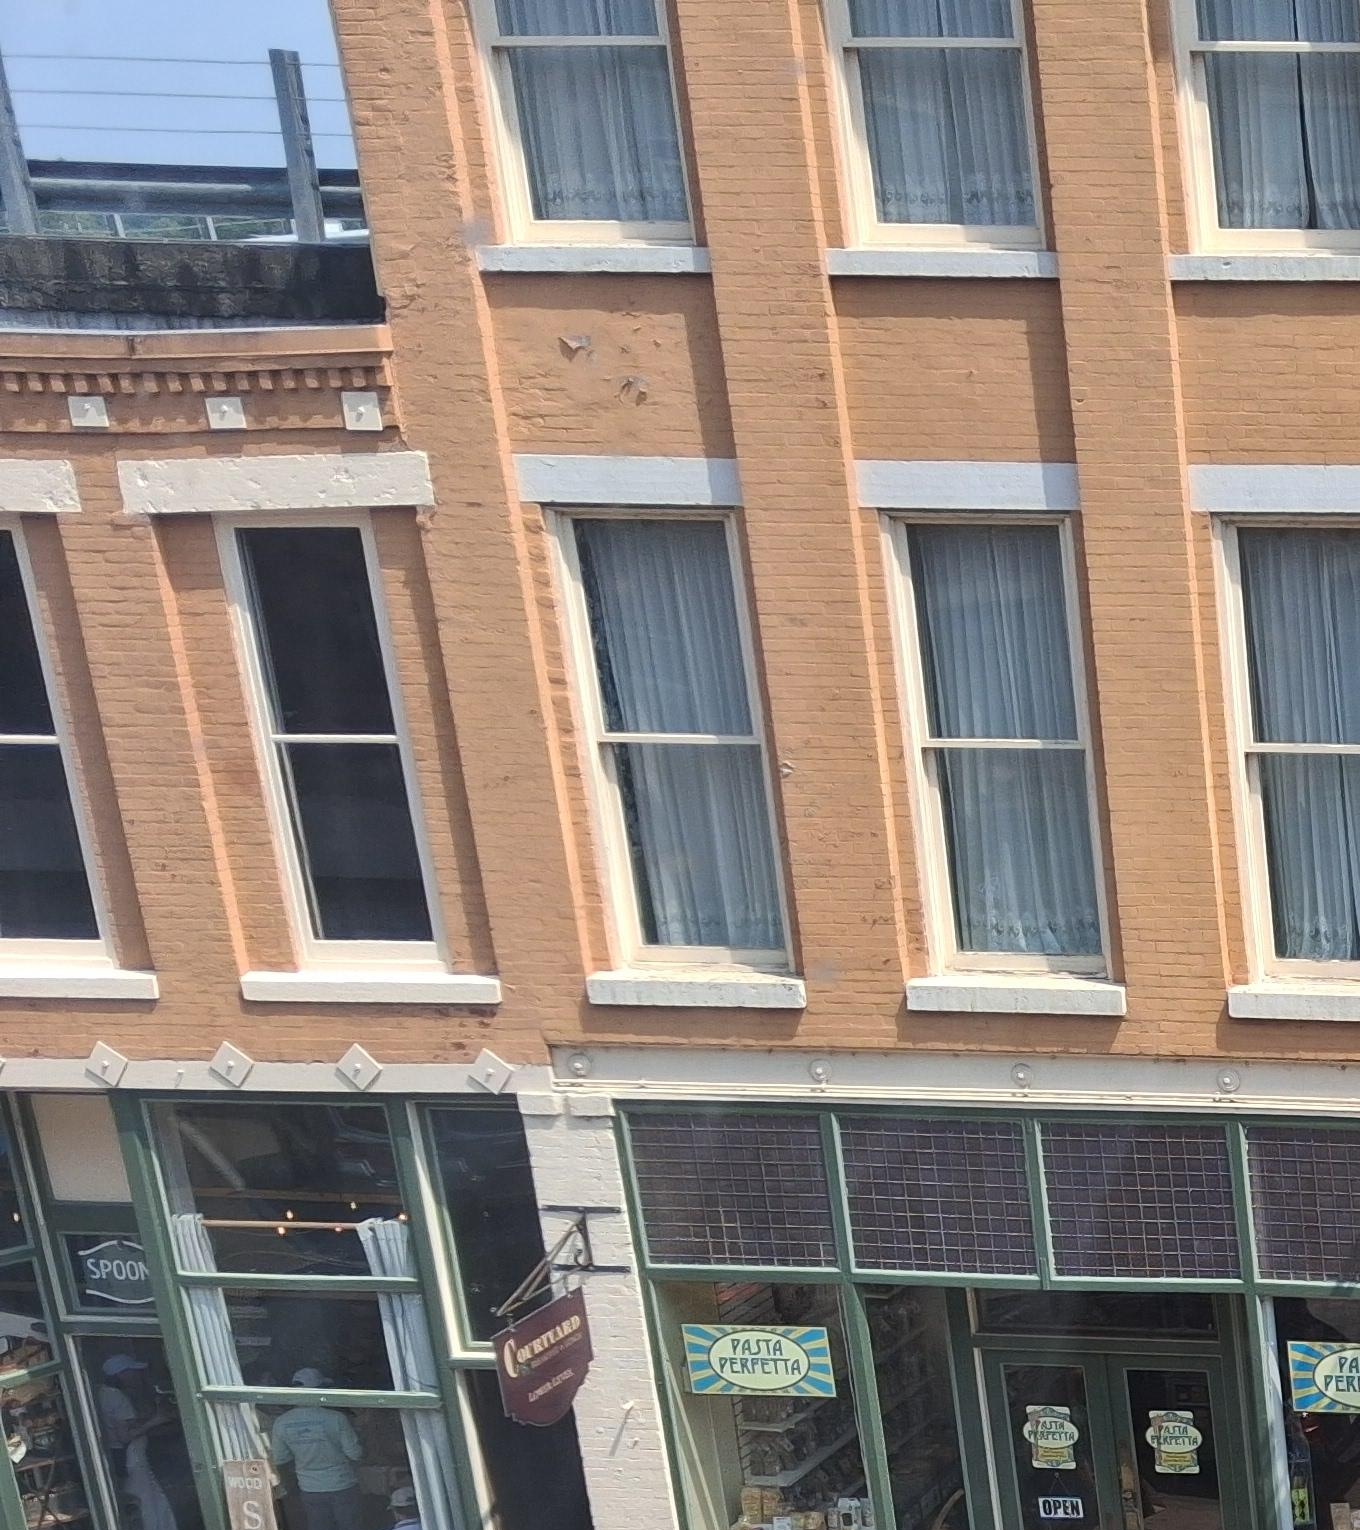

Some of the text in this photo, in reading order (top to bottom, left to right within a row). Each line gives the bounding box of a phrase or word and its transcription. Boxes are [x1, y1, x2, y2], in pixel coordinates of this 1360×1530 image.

[730, 1338, 783, 1356] PASTA
[718, 1357, 802, 1376] PERFETTA
[1042, 1499, 1081, 1517] OPEN
